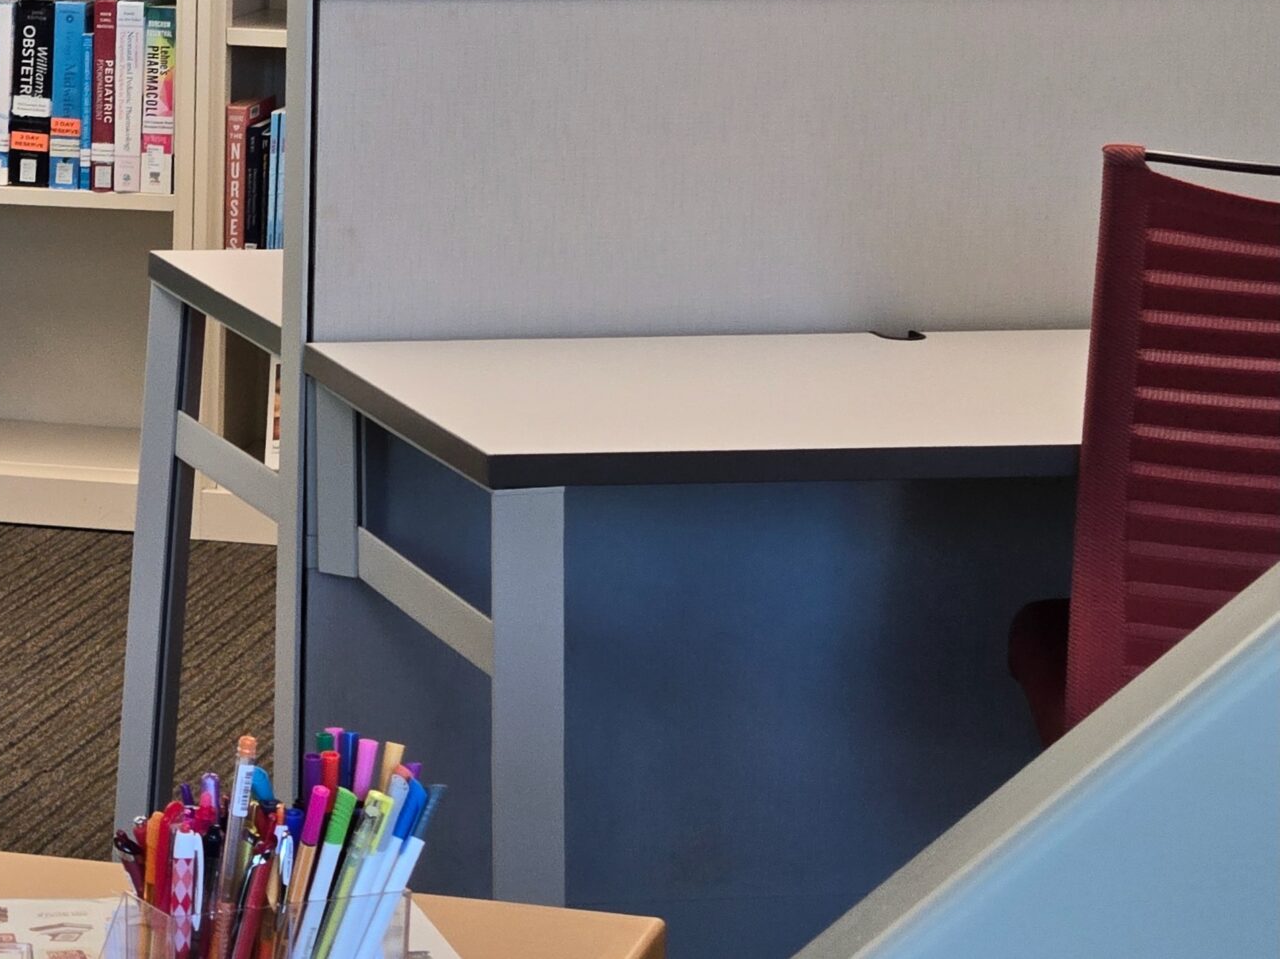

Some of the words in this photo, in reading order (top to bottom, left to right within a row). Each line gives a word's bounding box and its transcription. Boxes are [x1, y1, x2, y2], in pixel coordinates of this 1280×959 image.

[20, 25, 36, 95] OBSTETR
[126, 31, 134, 61] Neonatal
[159, 45, 170, 76] Lehne's
[33, 47, 48, 98] Williams
[104, 60, 113, 124] PEDIATRIC
[123, 106, 132, 152] Pharmacology
